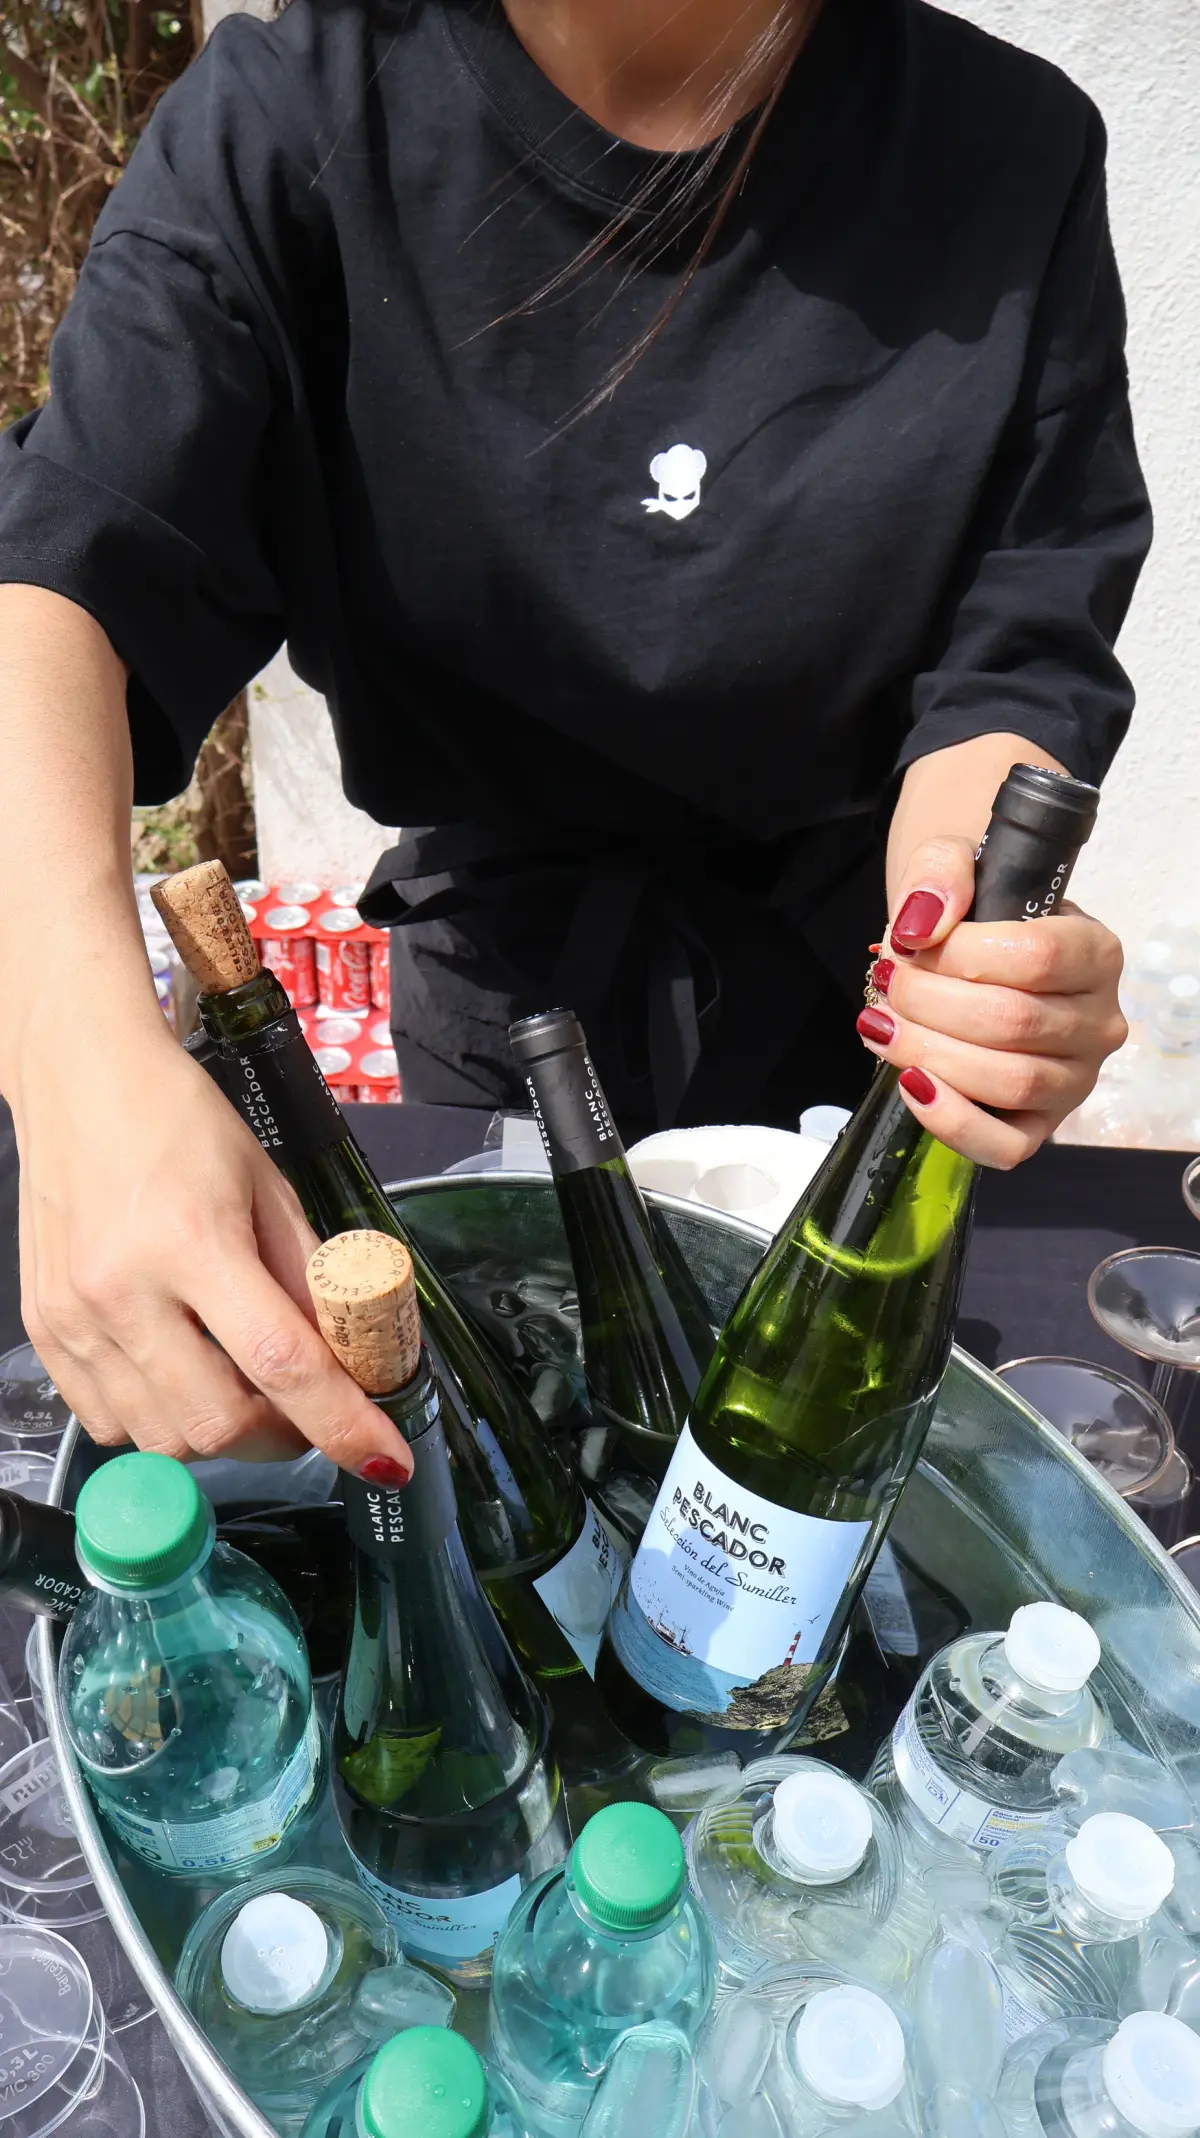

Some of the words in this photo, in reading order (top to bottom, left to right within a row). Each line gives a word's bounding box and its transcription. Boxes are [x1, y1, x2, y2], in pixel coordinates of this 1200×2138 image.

[1041, 863, 1068, 918] ADOR
[240, 1056, 284, 1147] PESCADOR
[242, 1092, 271, 1148] BLANC
[526, 1075, 553, 1158] PESCADOR
[583, 1056, 615, 1138] PESCADOR
[584, 1089, 608, 1142] BLANC
[366, 1492, 385, 1542] BLANC
[385, 1488, 405, 1543] PESCA
[672, 1485, 788, 1579] PESCADOR
[692, 1480, 770, 1545] BLANC
[659, 1505, 699, 1562] Selección
[700, 1554, 729, 1578] del
[724, 1571, 798, 1606] Sumiller
[684, 1564, 698, 1579] Vino
[704, 1582, 726, 1597] Aguja
[27, 2054, 56, 2083] 300
